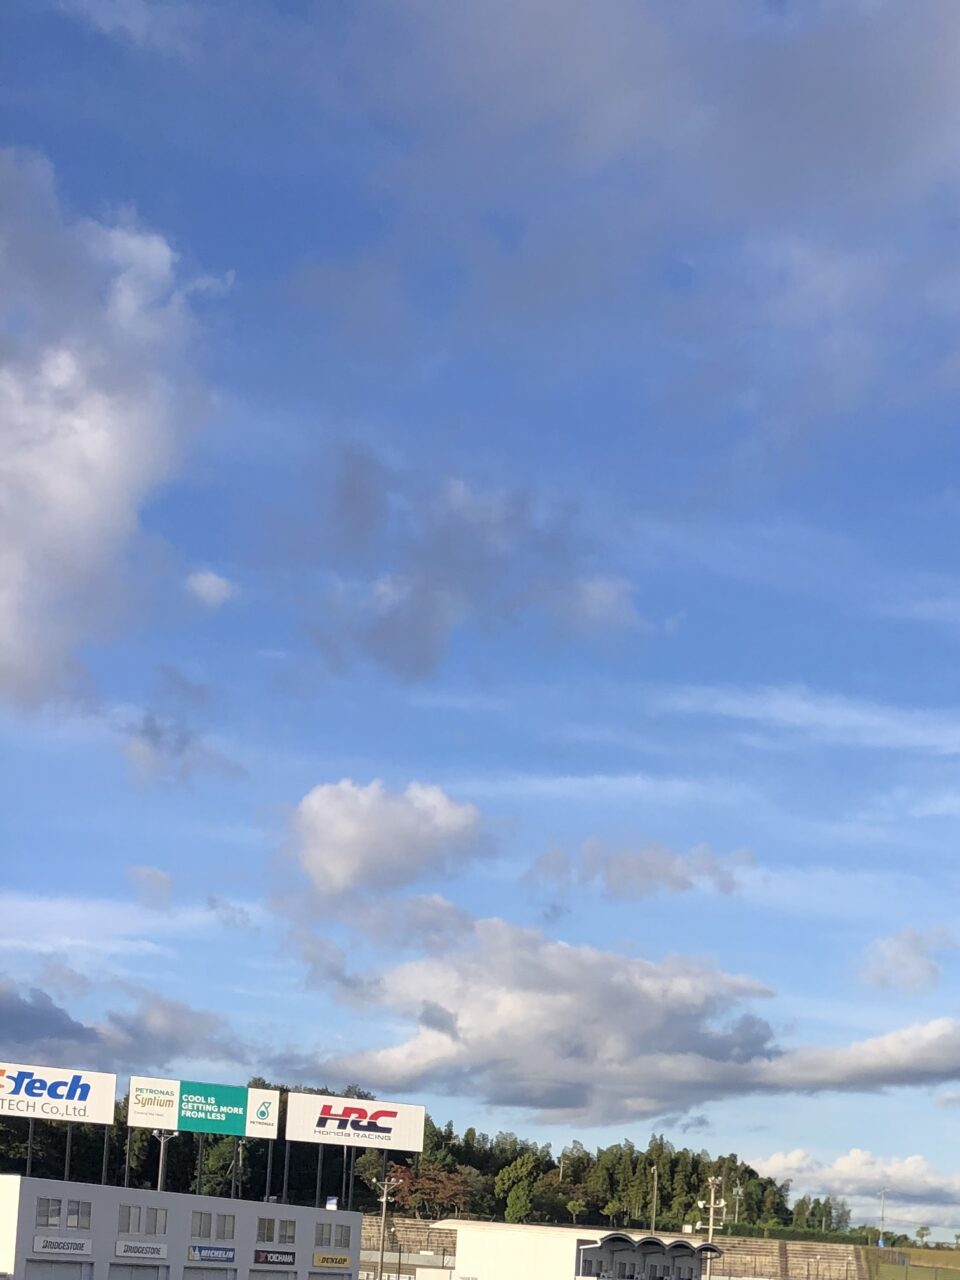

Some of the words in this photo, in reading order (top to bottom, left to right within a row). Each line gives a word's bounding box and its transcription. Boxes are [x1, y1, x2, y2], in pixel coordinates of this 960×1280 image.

[135, 1087, 175, 1097] PETRONAS
[134, 1094, 174, 1108] Syntium
[182, 1094, 206, 1103] COOL
[207, 1096, 215, 1104] IS
[181, 1102, 218, 1112] GETTING
[219, 1105, 244, 1115] MORE
[181, 1110, 206, 1119] FROM
[207, 1112, 226, 1121] LESS
[316, 1104, 398, 1134] HRC
[313, 1129, 351, 1137] Honda
[352, 1132, 392, 1141] RACING
[42, 1239, 85, 1251] BRIDGESTONE
[123, 1244, 162, 1256] BRIDGESTONE
[200, 1247, 234, 1259] MICHELIN
[320, 1256, 348, 1265] DUNLOP
